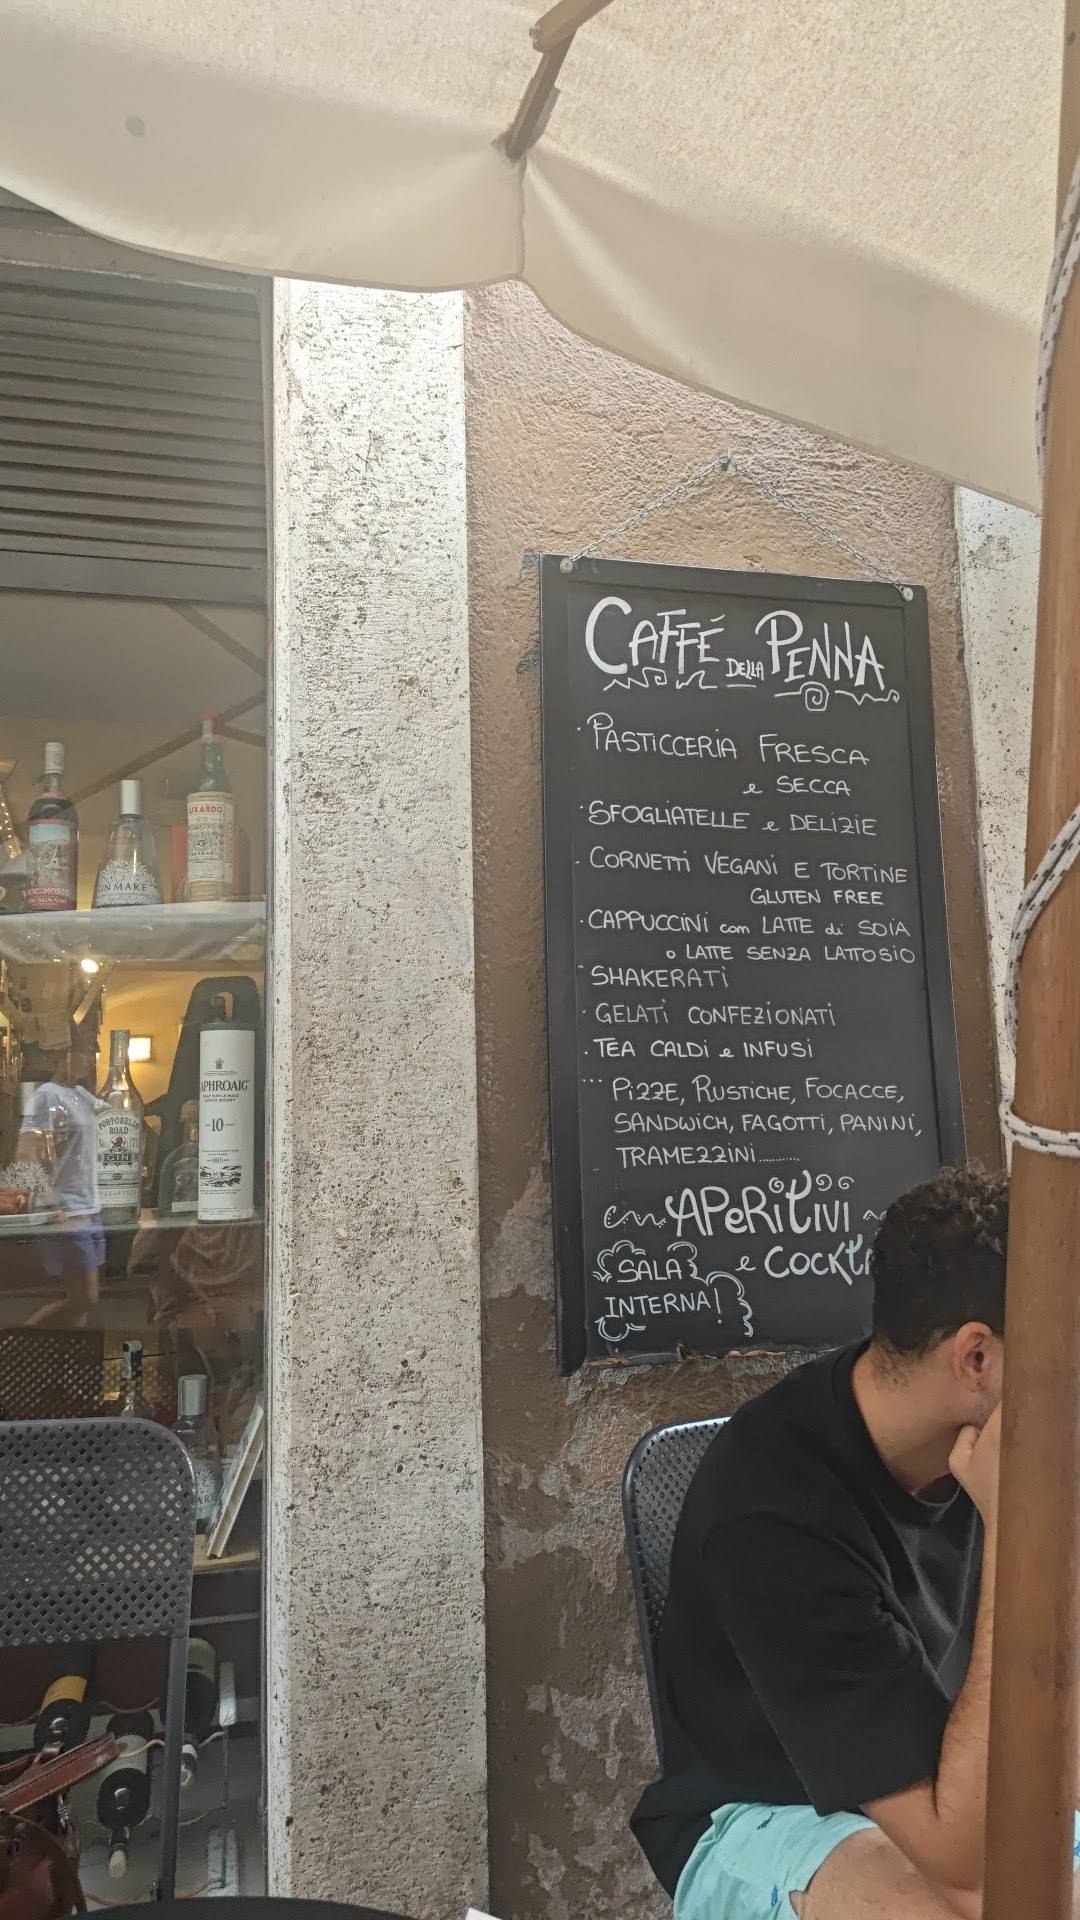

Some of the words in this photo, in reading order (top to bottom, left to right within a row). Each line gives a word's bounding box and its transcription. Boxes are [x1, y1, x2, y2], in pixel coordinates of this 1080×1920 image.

[726, 657, 765, 681] DELLA
[755, 610, 885, 691] PENNA
[587, 712, 736, 759] PASTICCERIA
[760, 734, 869, 765] FRESCA
[777, 776, 851, 796] SECCA
[589, 800, 750, 829] SFOGLIATELLE
[790, 814, 876, 835] DELIZIE
[590, 846, 690, 872] CORNETTI
[704, 851, 777, 875] VEGANI
[795, 862, 809, 878] E
[820, 862, 907, 883] TORTINE
[113, 882, 147, 891] MARE
[751, 888, 821, 905] GLUTEN
[833, 890, 883, 905] FREE
[588, 909, 708, 932] CAPPUCCINI
[763, 916, 814, 934] LATTE
[825, 923, 843, 935] di
[858, 918, 910, 936] SOIA
[686, 944, 733, 960] LATTE
[747, 946, 811, 961] SENZA
[825, 945, 915, 963] LATTOSIO
[591, 965, 728, 987] SHAKERATI
[596, 999, 668, 1024] GELATI
[688, 1001, 835, 1026] CONFEZIONATI
[593, 1038, 635, 1057] TEA
[650, 1040, 709, 1057] CALDI
[744, 1039, 812, 1057] INFUSI
[613, 1077, 684, 1105] PIZZE,
[692, 1075, 795, 1104] RUSTICHE,
[806, 1078, 903, 1103] FOCACCE,
[98, 1116, 140, 1130] PORTOBELLO
[109, 1126, 129, 1135] ROAD
[212, 1118, 224, 1131] 10
[615, 1112, 733, 1134] SANDWICH,
[742, 1114, 833, 1135] FAGOTTI,
[840, 1113, 921, 1136] PANINI,
[106, 1154, 129, 1162] GIN
[617, 1259, 682, 1282] SALA
